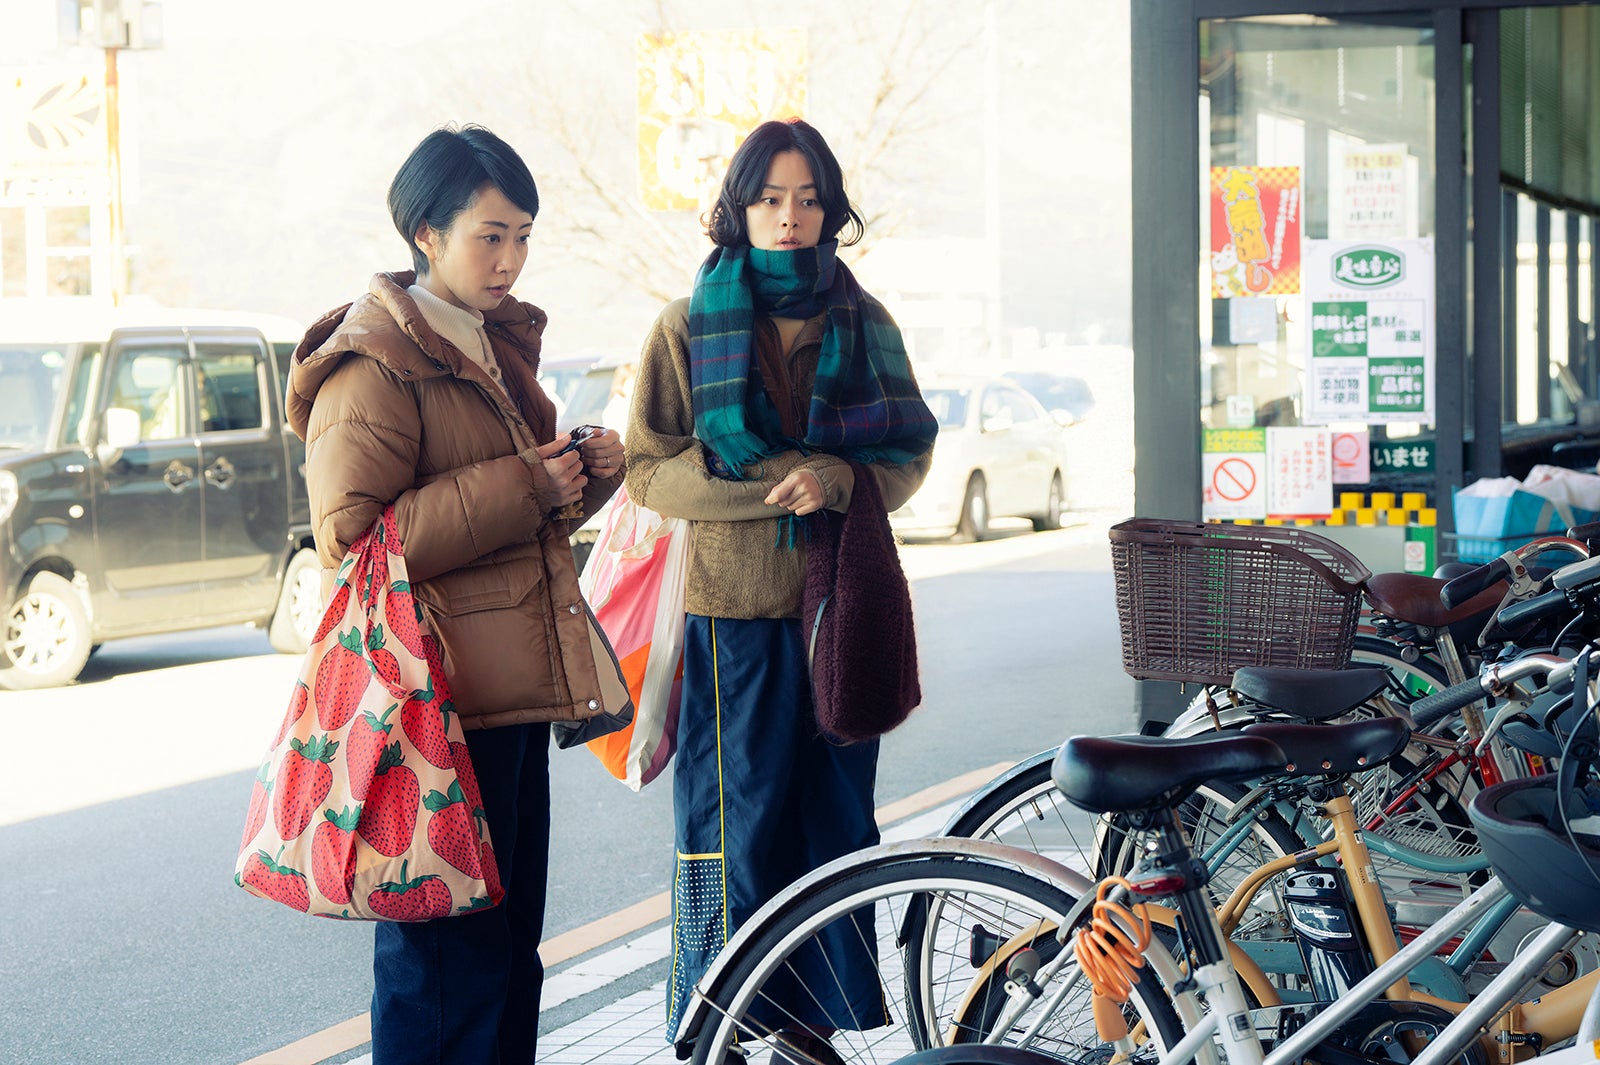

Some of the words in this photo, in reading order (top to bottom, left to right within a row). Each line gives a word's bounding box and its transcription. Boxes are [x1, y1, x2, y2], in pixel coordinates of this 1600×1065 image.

[1313, 314, 1366, 331] 美味しさ
[1320, 378, 1360, 390] 添加物
[1320, 392, 1360, 404] 不使用
[1373, 446, 1430, 468] いませ
